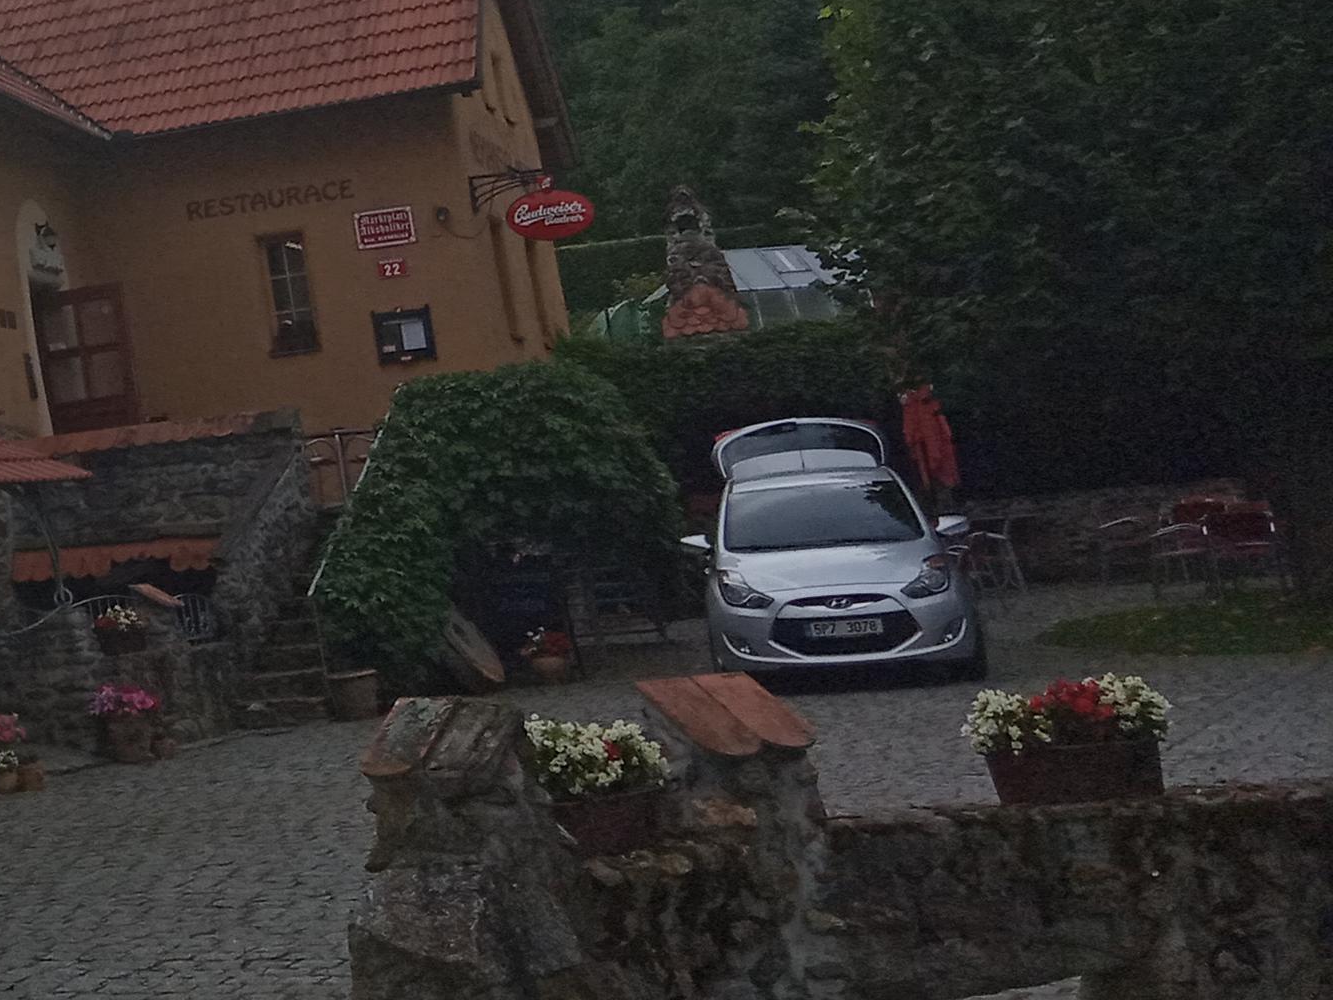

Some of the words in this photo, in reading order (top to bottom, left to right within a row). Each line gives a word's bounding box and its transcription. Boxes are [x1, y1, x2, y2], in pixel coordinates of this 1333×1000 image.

[185, 178, 355, 222] RESTAURACE
[514, 201, 586, 225] Budweiser
[383, 263, 401, 276] 22
[813, 622, 836, 635] 5P7
[846, 620, 878, 633] 3078
